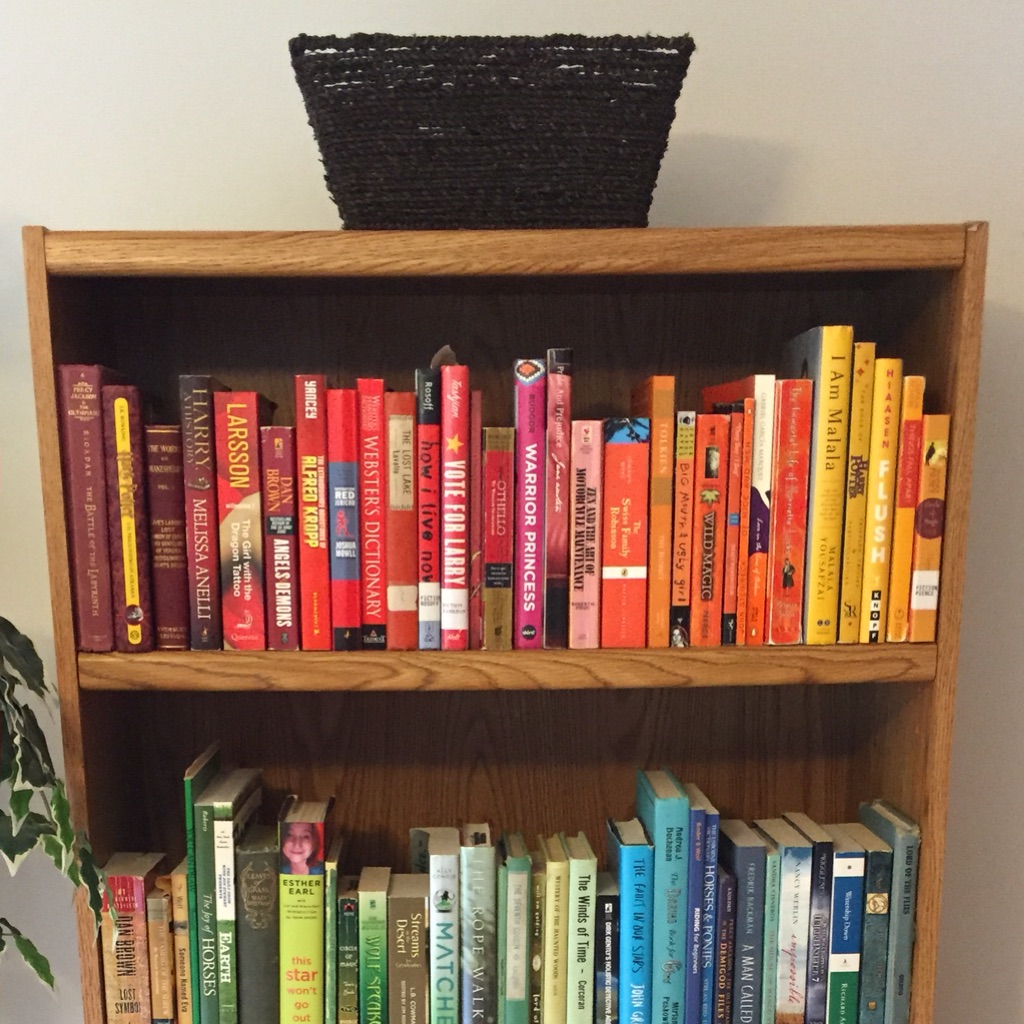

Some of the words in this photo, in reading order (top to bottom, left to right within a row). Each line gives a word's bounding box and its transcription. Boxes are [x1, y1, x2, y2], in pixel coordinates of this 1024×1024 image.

[424, 382, 433, 410] Rosoff
[830, 370, 843, 400] Am
[227, 403, 250, 488] LARSSON
[825, 409, 841, 471] Malala
[267, 469, 279, 512] BROWN
[281, 477, 292, 503] DAN
[364, 436, 380, 515] WEBSTER'S
[444, 461, 464, 497] VOTE
[525, 443, 537, 526] WARRIOR
[445, 505, 465, 534] FOR
[621, 498, 631, 524] Swiss
[872, 460, 889, 563] FLUSH
[194, 499, 207, 562] MELISSA
[230, 523, 241, 559] Dragon
[619, 528, 630, 557] Family
[703, 511, 715, 549] WILD
[274, 539, 290, 578] ANGELS
[364, 521, 380, 618] DICTIONARY
[445, 538, 465, 585] LARRY
[524, 532, 536, 612] PRINCESS
[196, 566, 210, 619] ANELLI
[233, 562, 242, 597] Tattoo
[701, 554, 713, 600] MAGIC
[275, 582, 291, 627] DEMONS
[578, 875, 590, 890] The
[200, 911, 212, 923] Joy
[203, 894, 212, 909] The
[577, 896, 590, 923] Winds
[116, 916, 133, 935] DAN
[203, 925, 213, 934] of
[396, 920, 407, 954] Desert
[409, 913, 422, 958] Streams
[577, 928, 589, 936] of
[116, 940, 135, 976] BROWN
[202, 938, 216, 996] HORSES
[219, 931, 232, 983] EARTH
[577, 941, 589, 962] Time
[741, 956, 753, 980] MAN
[286, 970, 317, 980] star
[632, 983, 646, 1007] JOHN
[740, 985, 753, 1023] CALLED
